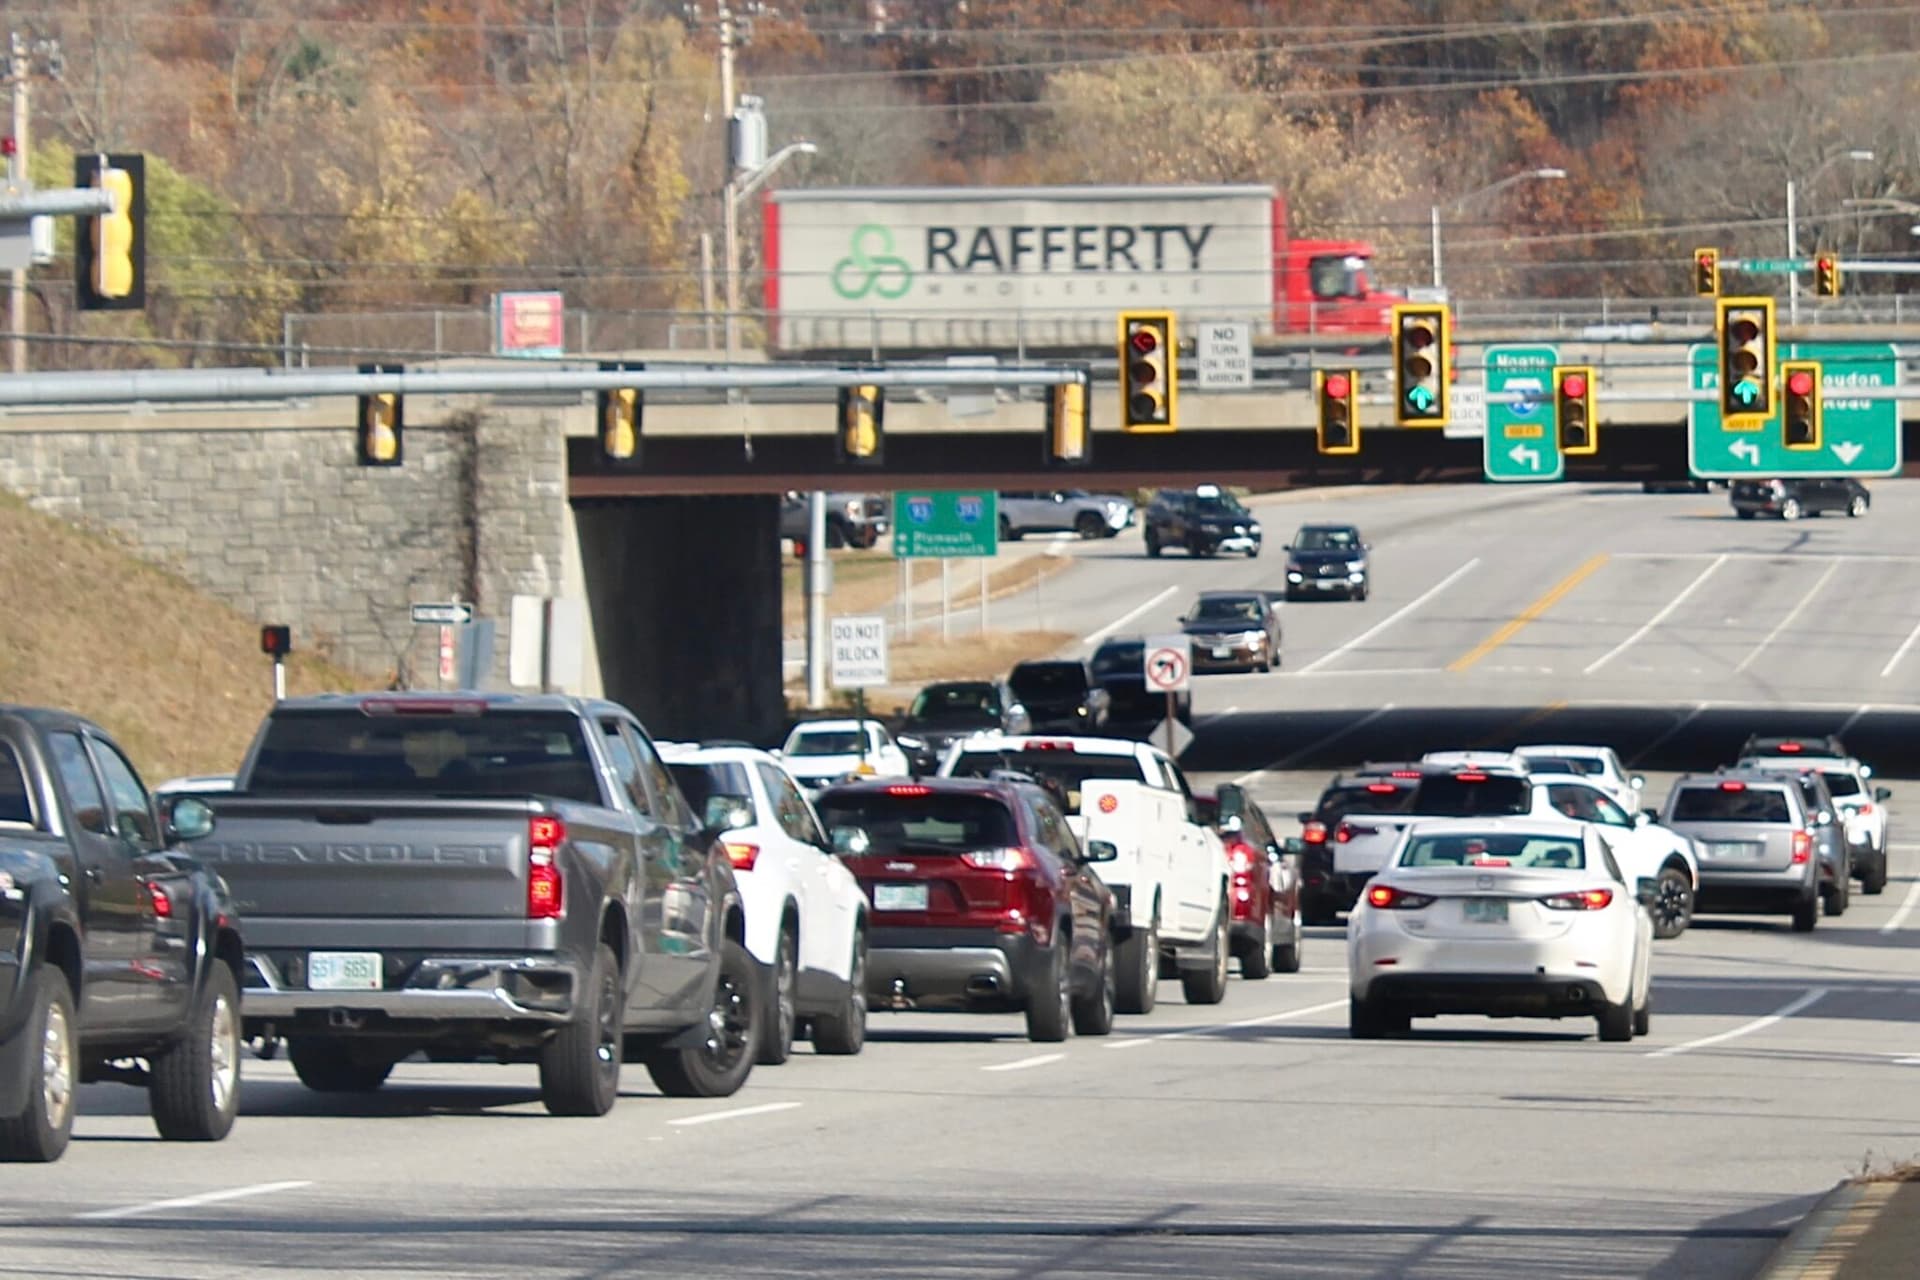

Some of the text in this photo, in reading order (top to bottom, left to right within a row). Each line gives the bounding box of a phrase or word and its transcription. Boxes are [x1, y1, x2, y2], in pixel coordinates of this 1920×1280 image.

[926, 225, 1213, 272] RAFFERTY
[1213, 328, 1234, 340] NO
[1211, 344, 1239, 355] TURN
[1823, 372, 1881, 386] oudon
[834, 624, 880, 639] DO NOT
[838, 646, 880, 661] BLOCK
